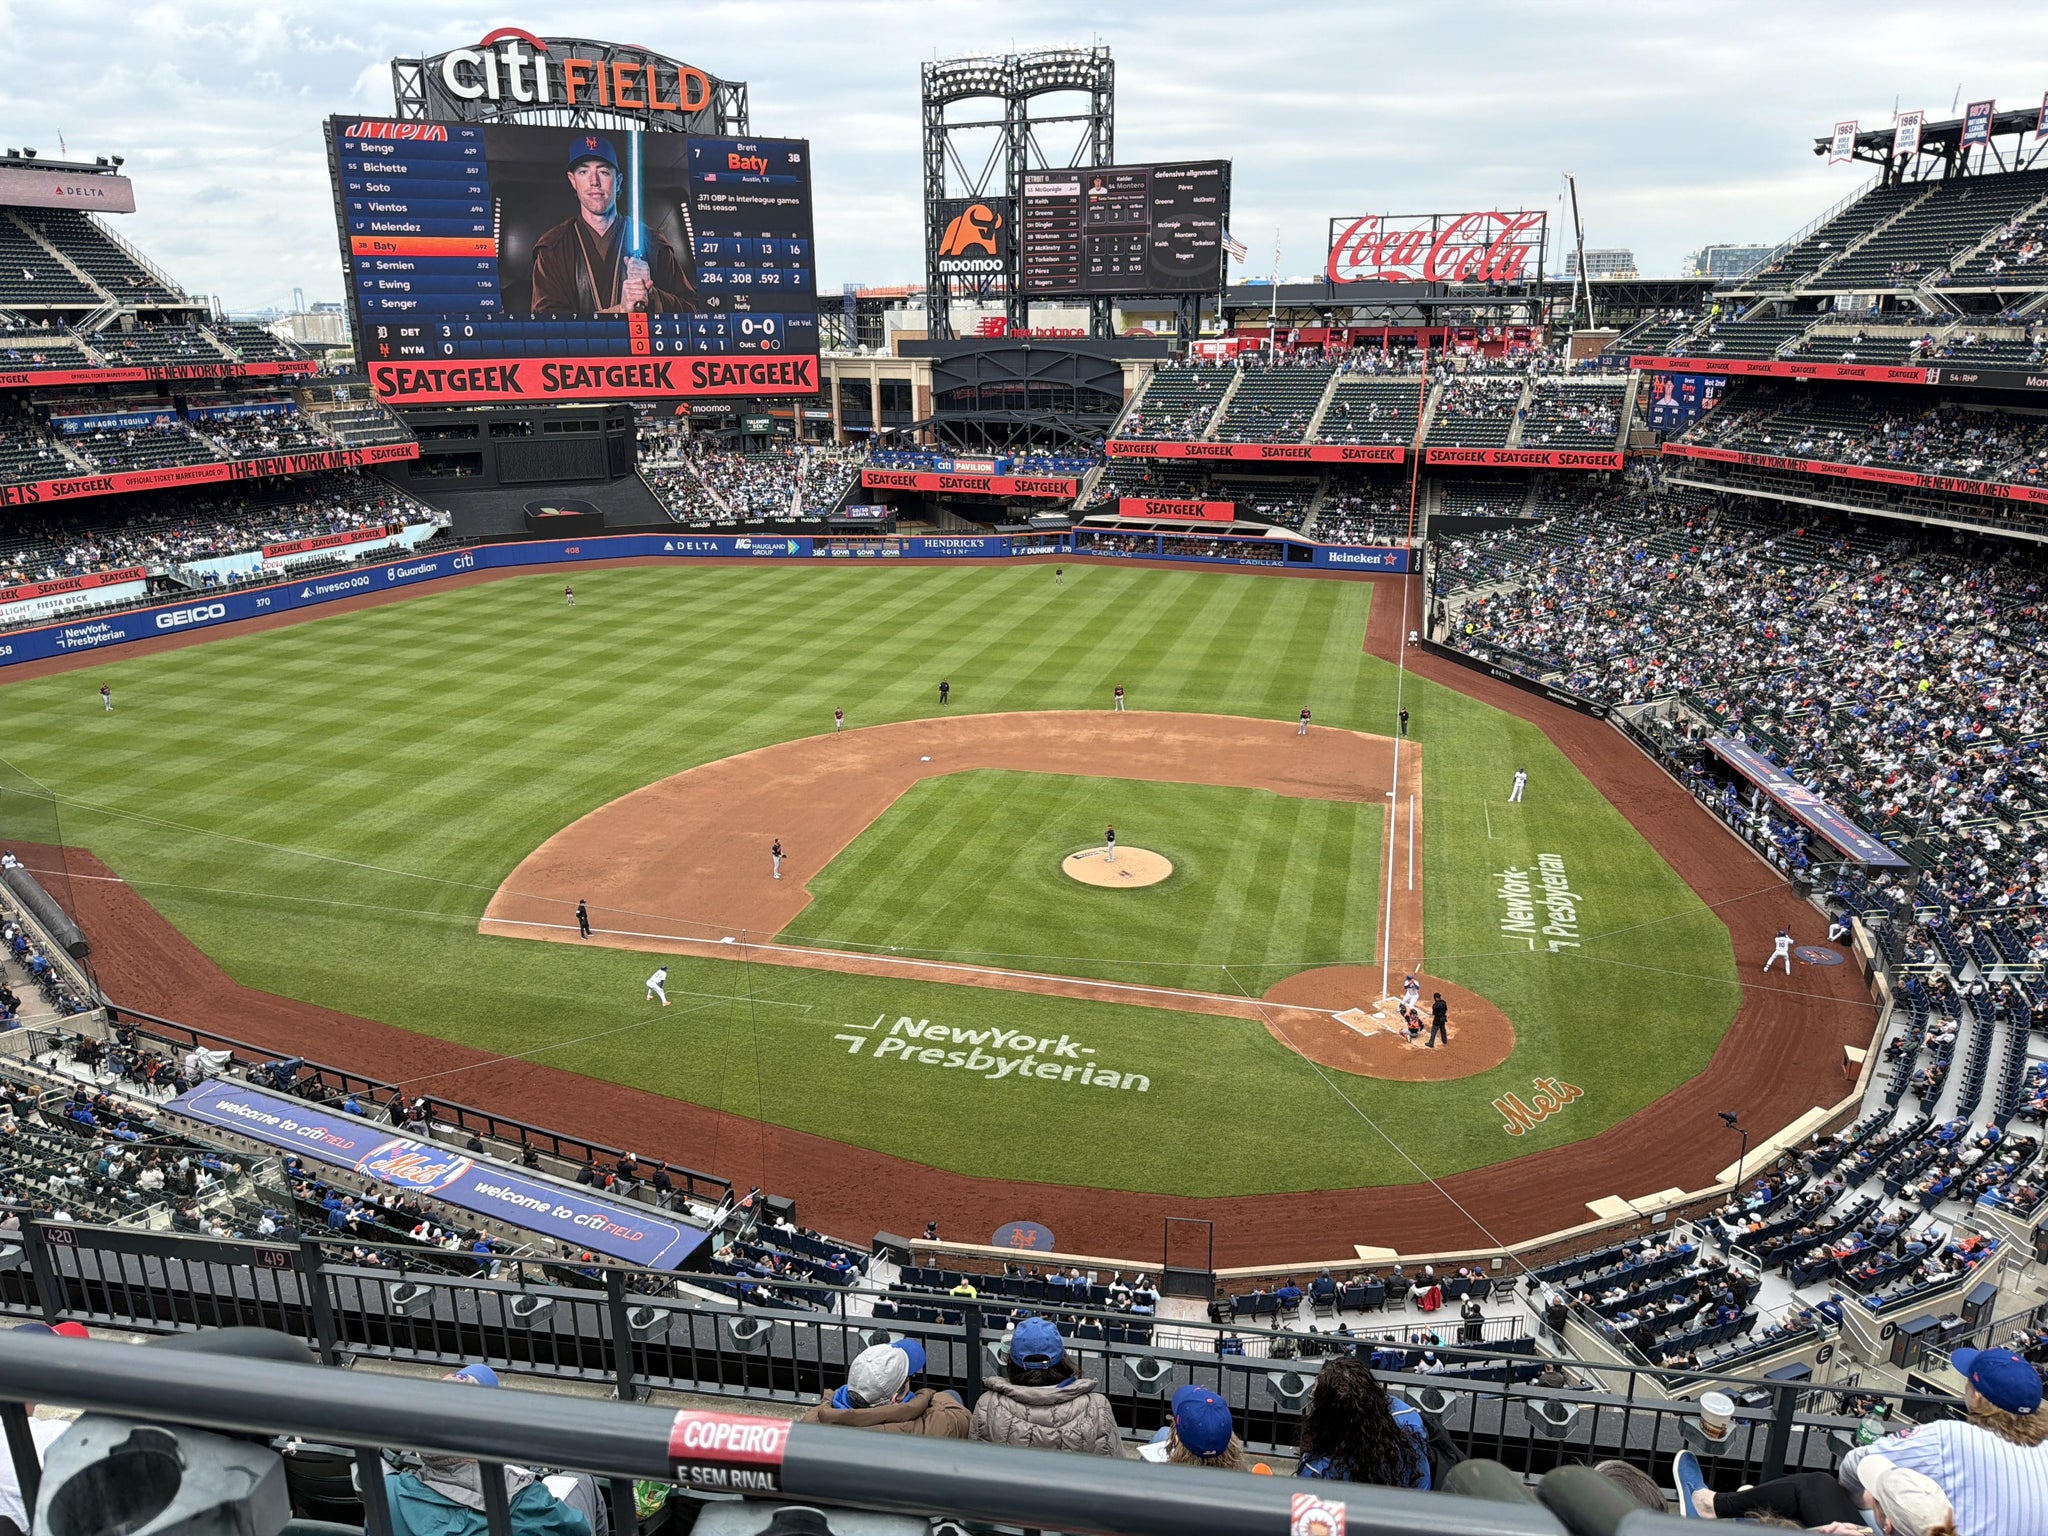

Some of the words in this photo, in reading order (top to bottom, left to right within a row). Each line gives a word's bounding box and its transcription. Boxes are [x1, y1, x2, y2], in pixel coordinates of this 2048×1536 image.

[442, 40, 550, 102] citi
[564, 58, 710, 111] FIELD
[1900, 114, 1918, 128] 1986
[1838, 125, 1854, 135] 1969
[361, 143, 394, 154] Benge
[736, 144, 757, 152] Brett
[363, 163, 408, 173] Bichette
[728, 153, 768, 176] Baty
[67, 186, 104, 198] DELTA
[366, 182, 390, 192] Soto
[368, 203, 408, 212] Vientos
[371, 222, 421, 232] Melendez
[374, 242, 397, 252] Baty
[700, 244, 718, 252] .217
[762, 244, 772, 254] 13
[790, 245, 800, 254] 16
[376, 261, 414, 270] Semien
[939, 259, 1003, 272] moomoo
[378, 280, 410, 292] Ewing
[700, 274, 722, 282] .284
[730, 274, 752, 283] .308
[758, 274, 780, 284] .592
[382, 299, 418, 310] Senger
[400, 328, 420, 336] DET
[1036, 326, 1084, 338] balance
[143, 367, 164, 380] THE
[165, 366, 188, 378] NEW
[190, 364, 219, 378] YORK
[220, 364, 247, 376] METS
[278, 362, 309, 372] SEATGEEK
[1888, 370, 1918, 380] SEATGEEK
[377, 364, 524, 397] SEATGEEK
[542, 361, 675, 392] SEATGEEK
[692, 360, 812, 388] SEATGEEK
[692, 404, 730, 412] moomoo
[119, 418, 150, 426] TEQUILA
[1112, 443, 1158, 454] SEATGEEK
[1186, 445, 1232, 456] SEATGEEK
[1261, 446, 1312, 458] SEATGEEK
[1342, 448, 1394, 460] SEATGEEK
[1430, 450, 1486, 462] SEATGEEK
[1494, 452, 1550, 464] SEATGEEK
[1558, 454, 1617, 466] SEATGEEK
[52, 477, 114, 497] SEATGEEK
[126, 476, 153, 486] OFFICIAL
[154, 474, 174, 483] TICKET
[225, 462, 254, 479] THE
[256, 457, 287, 476] NEW
[290, 453, 325, 472] YORK
[326, 450, 364, 467] METS
[371, 446, 413, 461] SEATGEEK
[938, 461, 951, 470] citi
[956, 462, 992, 472] PAVILION
[868, 474, 917, 488] SEATGEEK
[940, 476, 991, 491] SEATGEEK
[1014, 480, 1070, 494] SEATGEEK
[1916, 474, 1932, 487] THE
[1933, 476, 1955, 490] NEW
[1956, 479, 1982, 494] YORK
[1983, 483, 2010, 498] METS
[1146, 502, 1205, 518] SEATGEEK
[270, 542, 302, 555] SEATGEEK
[311, 536, 343, 548] SEATGEEK
[351, 528, 381, 542] SEATGEEK
[677, 542, 718, 550] DELTA
[925, 539, 984, 548] HENDRICK'S
[1027, 546, 1056, 554] DUNKIN'
[454, 554, 474, 569] citi
[1239, 559, 1284, 567] CADILLAC
[1329, 552, 1380, 564] Heineken
[397, 564, 436, 578] Guardian
[38, 579, 82, 594] SEATGEEK
[100, 569, 140, 584] SEATGEEK
[316, 582, 350, 595] Invesco
[351, 576, 370, 588] QQQ
[6, 605, 31, 616] LIGHT
[36, 599, 63, 610] FIESTA
[66, 594, 88, 604] DECK
[256, 598, 270, 608] 370
[156, 603, 226, 628] GEICO
[66, 622, 110, 638] NewYork-
[68, 630, 126, 648] Presbyterian
[1530, 853, 1582, 938] Presbyterian
[890, 1016, 1095, 1058] NewYork-
[873, 1038, 1150, 1092] Presbyterian
[1492, 1077, 1584, 1136] Mets
[216, 1100, 280, 1125] welcome
[278, 1119, 298, 1131] to
[370, 1152, 448, 1184] Mets
[474, 1182, 551, 1213] welcome
[551, 1205, 573, 1219] to
[47, 1230, 72, 1244] 420
[264, 1252, 284, 1267] 419
[684, 1422, 779, 1454] COPEIRO
[678, 1466, 690, 1482] E
[691, 1466, 728, 1488] SEM
[730, 1470, 777, 1492] RIVAL
